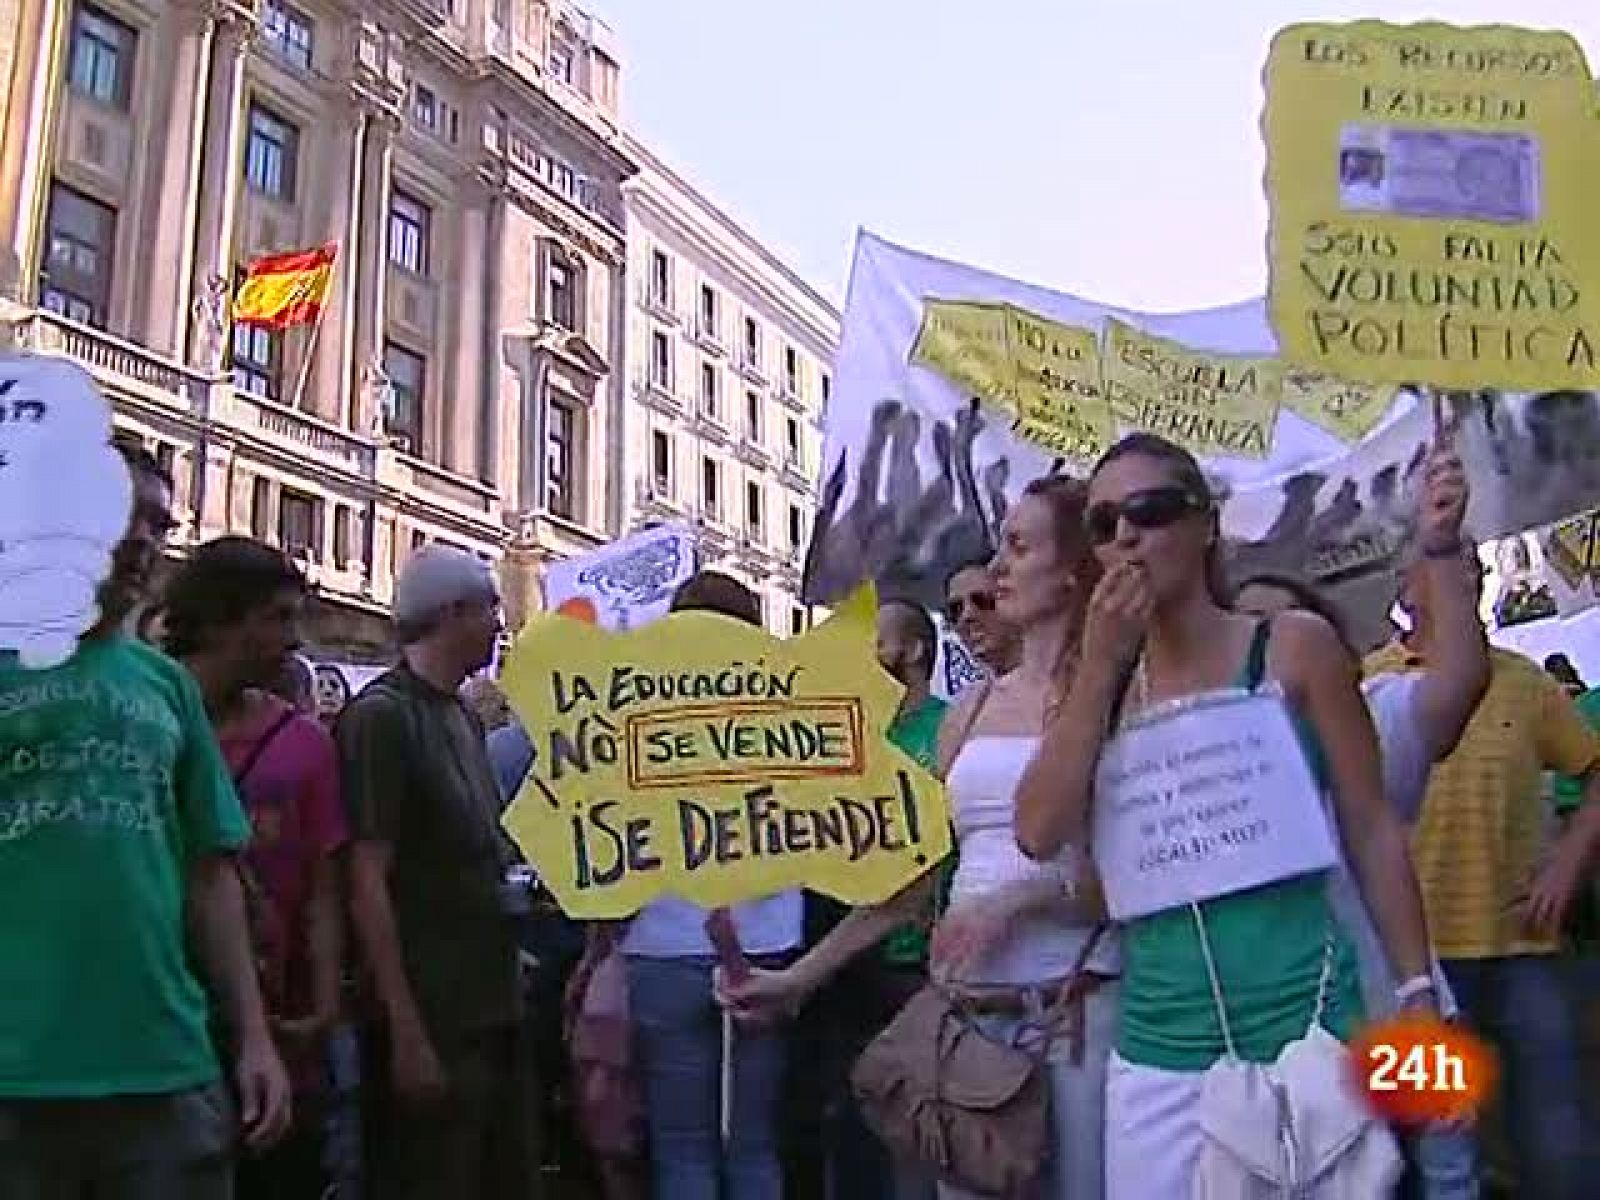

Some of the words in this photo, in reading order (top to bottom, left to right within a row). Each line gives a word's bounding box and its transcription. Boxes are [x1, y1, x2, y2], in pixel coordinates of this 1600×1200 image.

[1444, 235, 1562, 268] FALTA
[1300, 261, 1581, 313] VOLUNTAD
[1309, 309, 1595, 369] POLÍTICA
[1119, 339, 1257, 395] ESCUELA
[552, 669, 598, 714] LA
[645, 730, 698, 763] SE
[706, 717, 849, 762] VENDE
